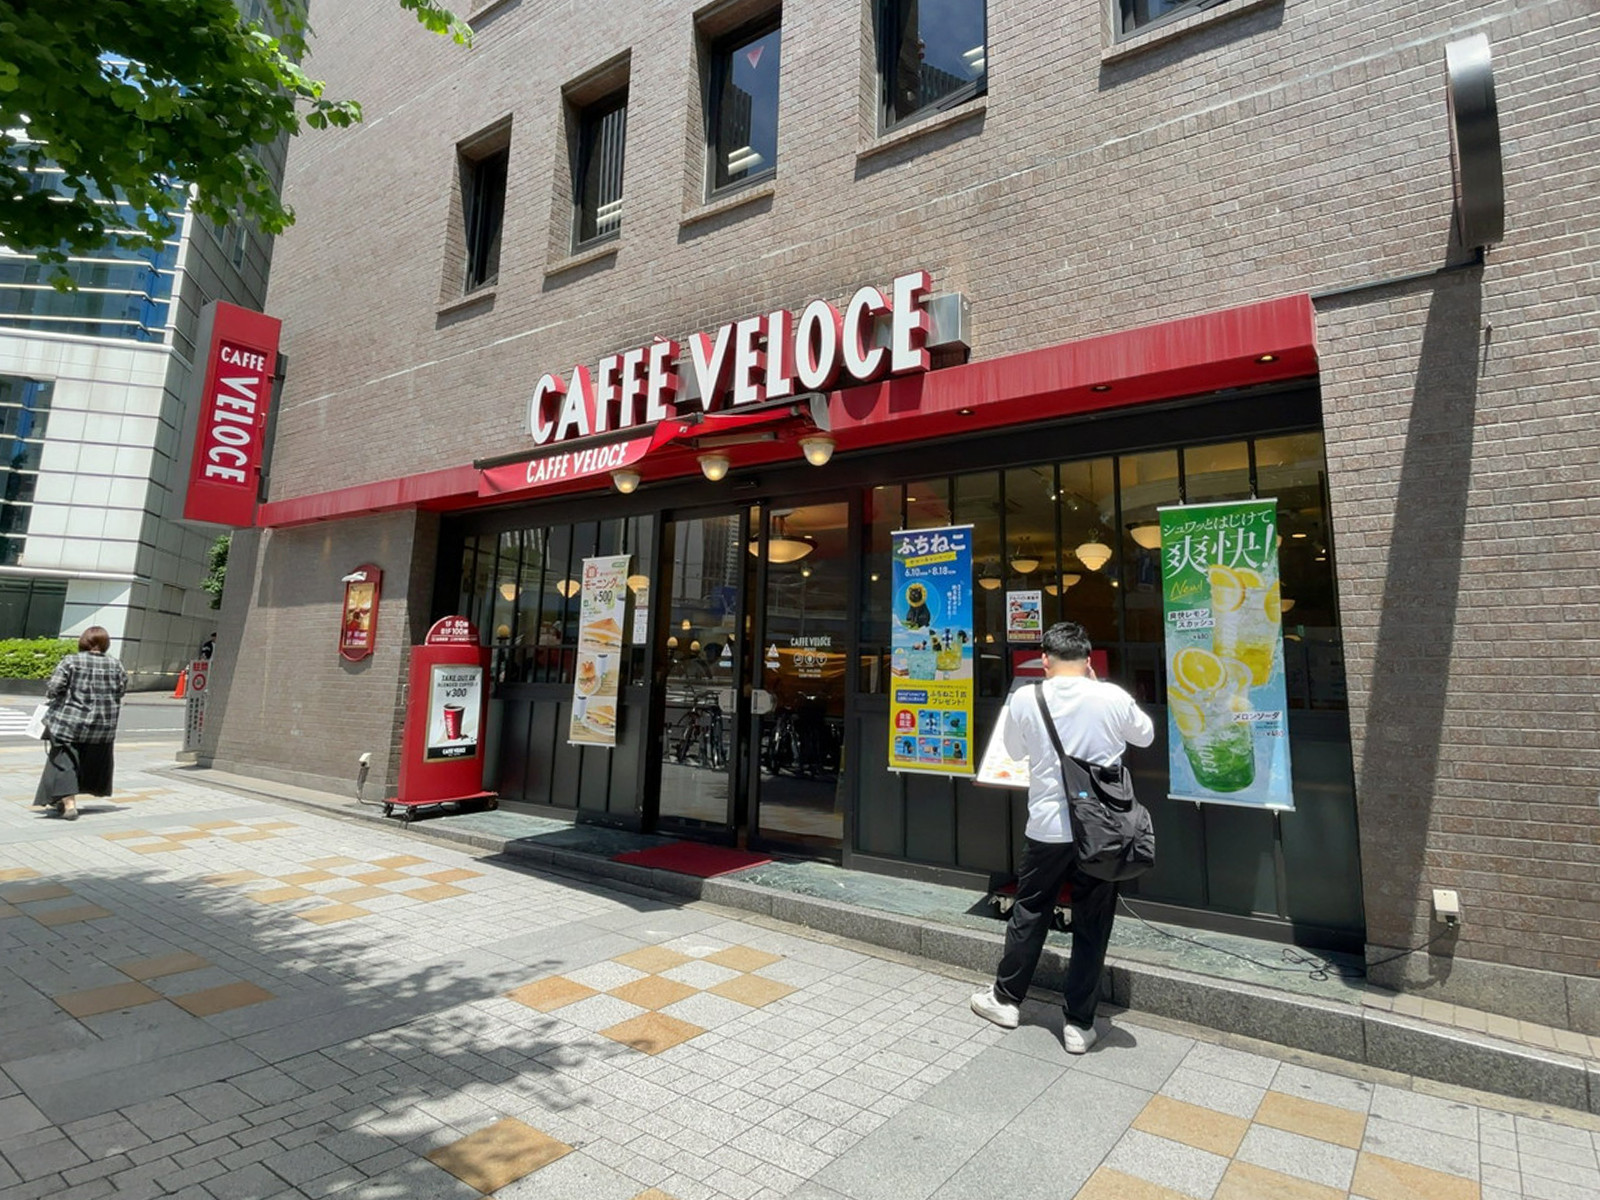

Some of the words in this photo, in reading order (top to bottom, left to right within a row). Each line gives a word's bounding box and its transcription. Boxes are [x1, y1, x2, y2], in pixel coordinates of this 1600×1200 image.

[689, 270, 930, 411] VELOCE
[205, 377, 259, 484] VELOCE
[573, 442, 629, 474] VELOCE
[1164, 509, 1272, 537] シュワッとはじけて
[897, 533, 966, 555] ふちねこ
[584, 577, 617, 590] モーニング
[1177, 620, 1214, 628] スカッシュ
[1233, 712, 1280, 720] メロンソーダ
